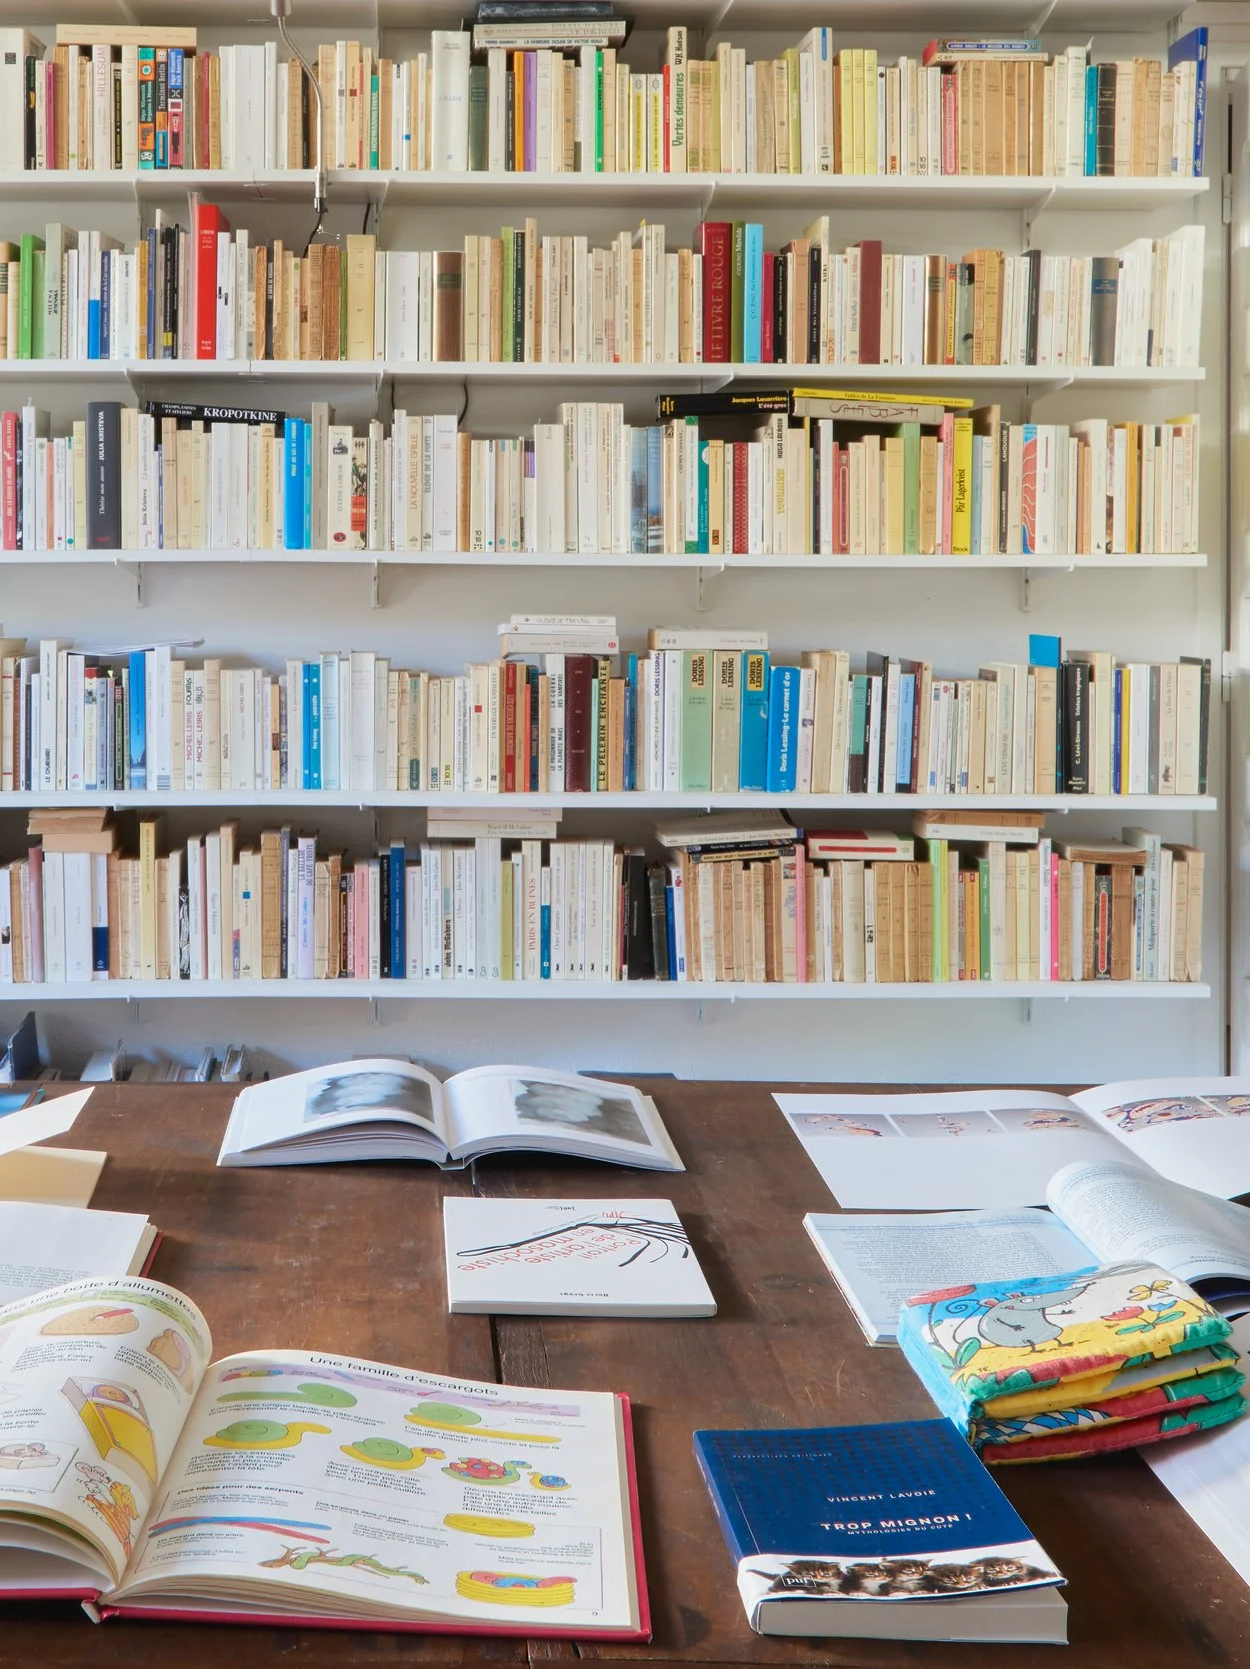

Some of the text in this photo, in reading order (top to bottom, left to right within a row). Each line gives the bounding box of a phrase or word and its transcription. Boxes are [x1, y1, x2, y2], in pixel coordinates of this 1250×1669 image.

[675, 30, 683, 51] Hudson
[97, 47, 107, 97] HILLESUM
[158, 83, 166, 110] Terminus
[672, 72, 683, 146] Vertes demeures
[712, 236, 724, 359] LE LIVRE ROUGE
[204, 407, 277, 421] KROPOTKINE
[425, 454, 431, 462] LA
[425, 463, 431, 472] DE
[956, 468, 967, 500] Lagerkvist
[411, 500, 418, 510] LA
[550, 700, 556, 708] LA
[598, 770, 606, 781] LE
[529, 912, 536, 923] EN
[444, 919, 452, 967] John McGahern
[456, 1227, 593, 1272] en masochiste
[524, 1232, 614, 1265] de l'artiste
[577, 1238, 641, 1259] Portrait
[30, 1291, 60, 1307] une
[107, 1278, 197, 1321] d'allumettes
[309, 1355, 498, 1398] Une famille d'escargots
[827, 1489, 937, 1504] VINCENT LAVOIE
[821, 1520, 873, 1532] TROP
[880, 1514, 961, 1528] MIGNON
[848, 1527, 912, 1536] MYTHOLOGIES
